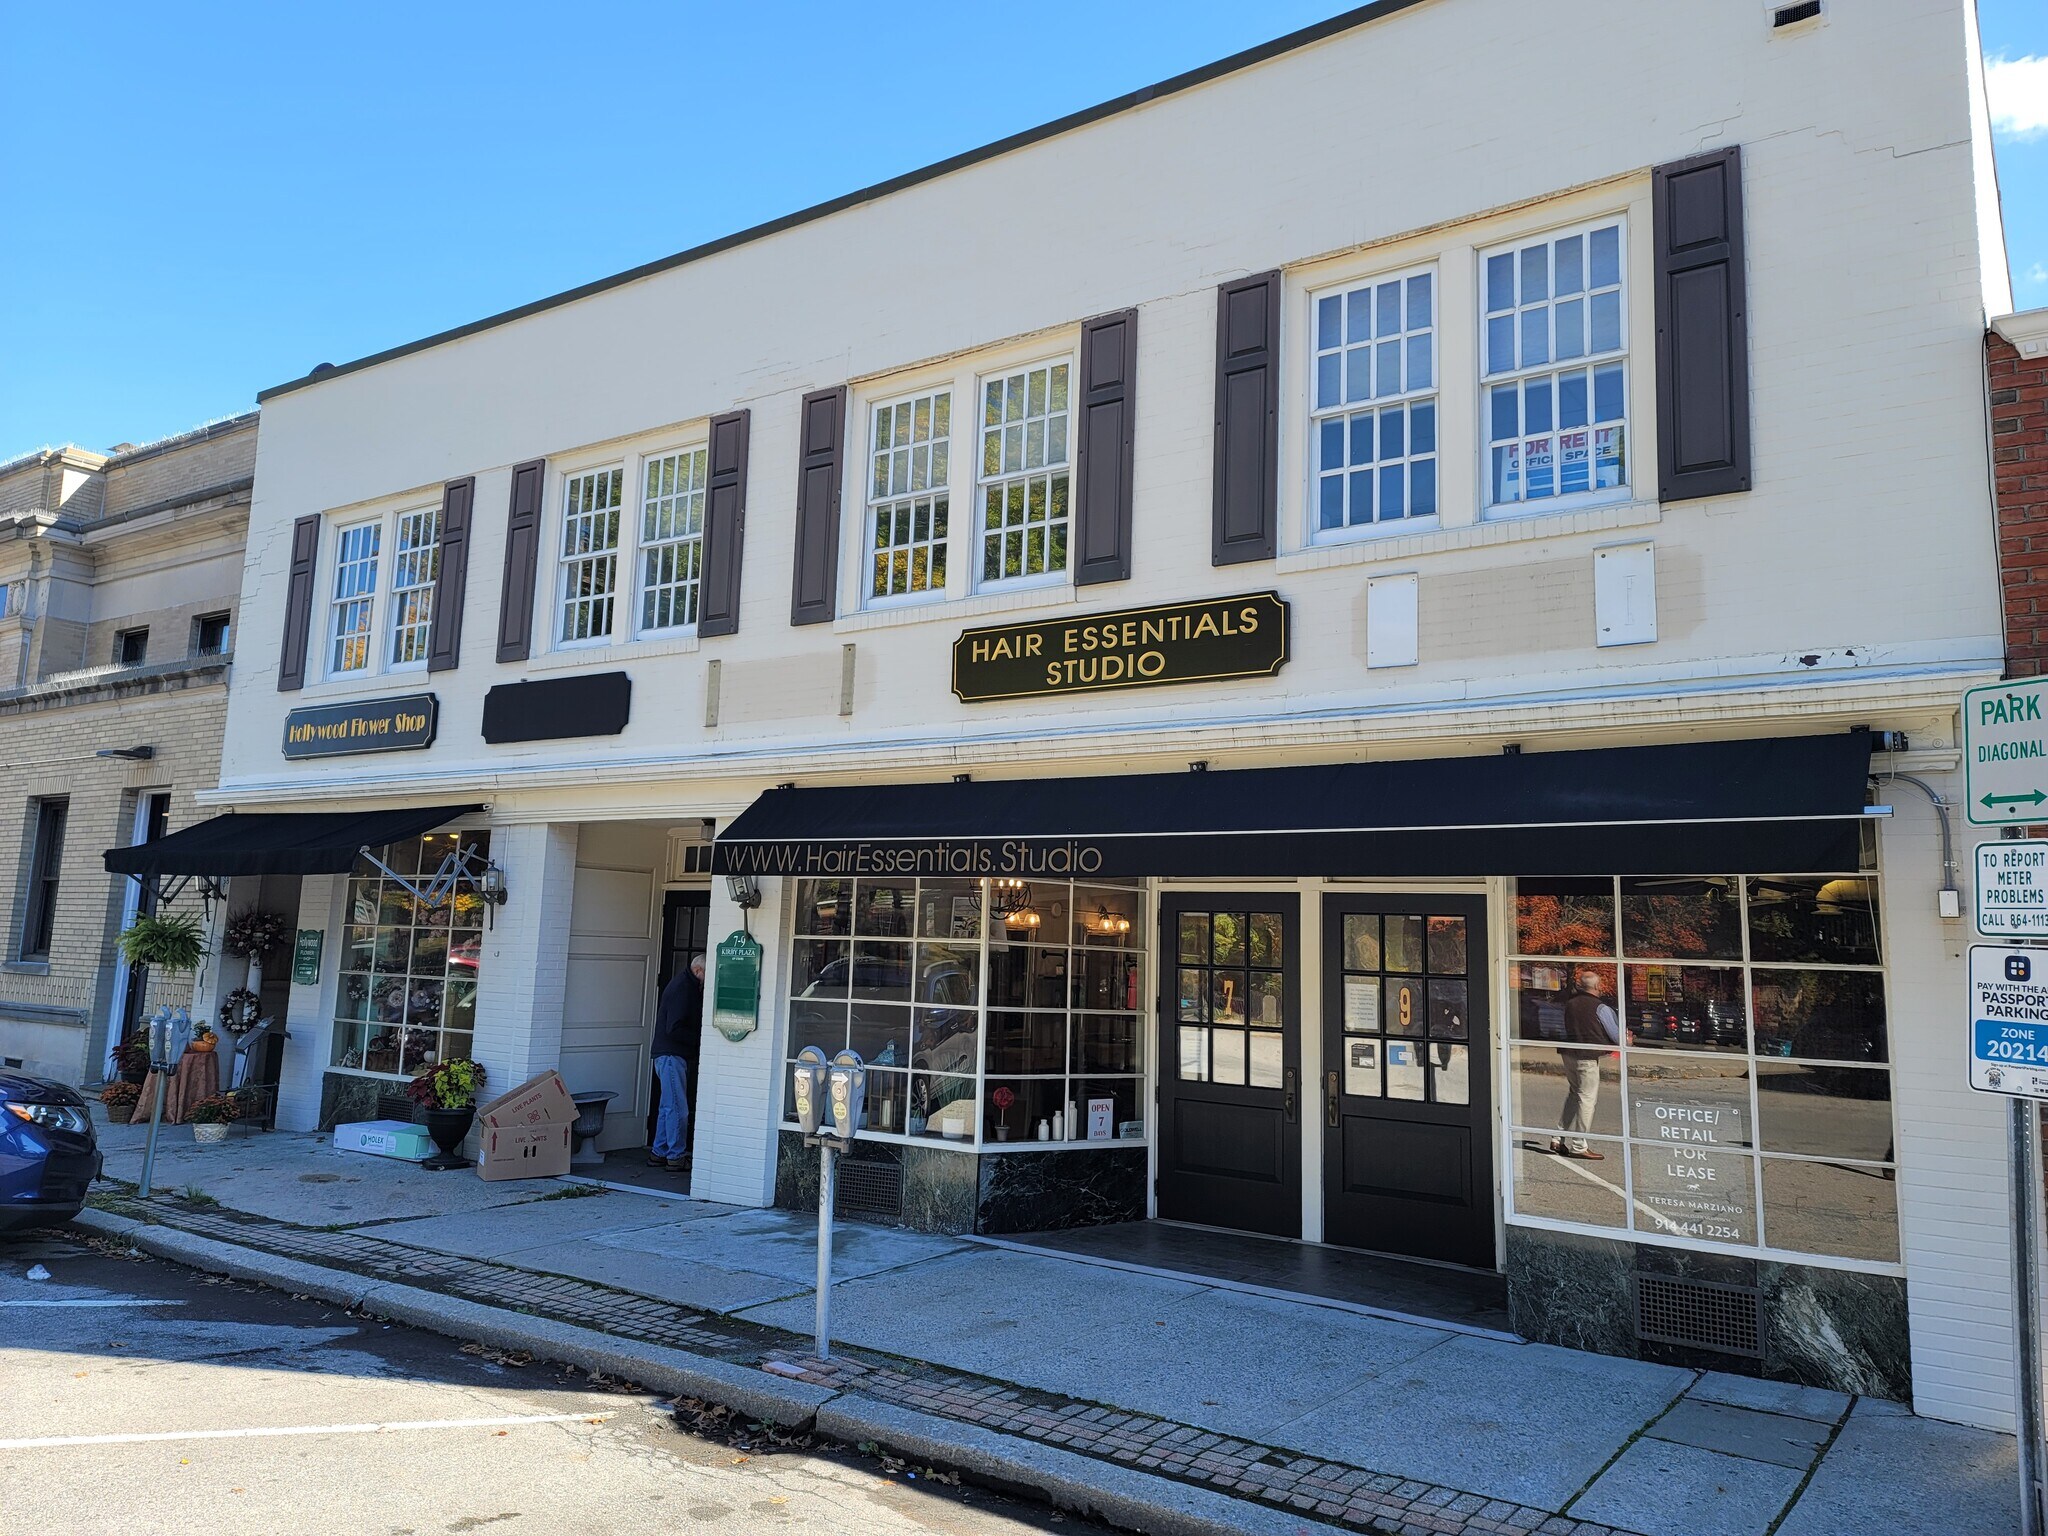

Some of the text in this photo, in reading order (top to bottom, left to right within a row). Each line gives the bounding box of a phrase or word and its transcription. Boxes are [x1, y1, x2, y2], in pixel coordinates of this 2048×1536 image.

[1508, 439, 1549, 458] FOR
[972, 607, 1258, 662] HAIR ESSENTIALS
[1046, 651, 1166, 686] STUDIO
[1981, 694, 2041, 726] PARK
[289, 712, 426, 743] Hollywood Flower Shop
[1978, 739, 2047, 763] DIAGONAL
[724, 840, 1103, 874] WWW.HairEssentials.Studio
[1983, 852, 2045, 867] TO REPORT
[1997, 871, 2032, 885] METER
[1987, 889, 2044, 904] PROBLEMS
[1982, 913, 2005, 926] CALL
[733, 935, 746, 948] 7-9
[1977, 982, 1994, 990] PAY
[1995, 983, 2020, 992] WITH
[2021, 985, 2039, 993] THE
[1223, 980, 1234, 1016] 7
[1399, 987, 1411, 1026] 9
[1986, 1004, 2048, 1020] PARKING
[2001, 1027, 2035, 1040] ZONE
[1987, 1040, 2048, 1063] 20214
[511, 1102, 525, 1114] LIVE
[522, 1092, 543, 1108] PLANTS
[1091, 1103, 1110, 1112] OPEN
[1098, 1116, 1105, 1127] 7
[1655, 1107, 1720, 1125] OFFICE/
[367, 1135, 385, 1144] HOLEX
[1660, 1126, 1718, 1143] RETAIL
[1674, 1148, 1707, 1161] FOR
[1667, 1164, 1716, 1181] LEASE
[1649, 1196, 1743, 1214] TERESA MARZIANO
[1655, 1218, 1740, 1239] 914 441 2254
